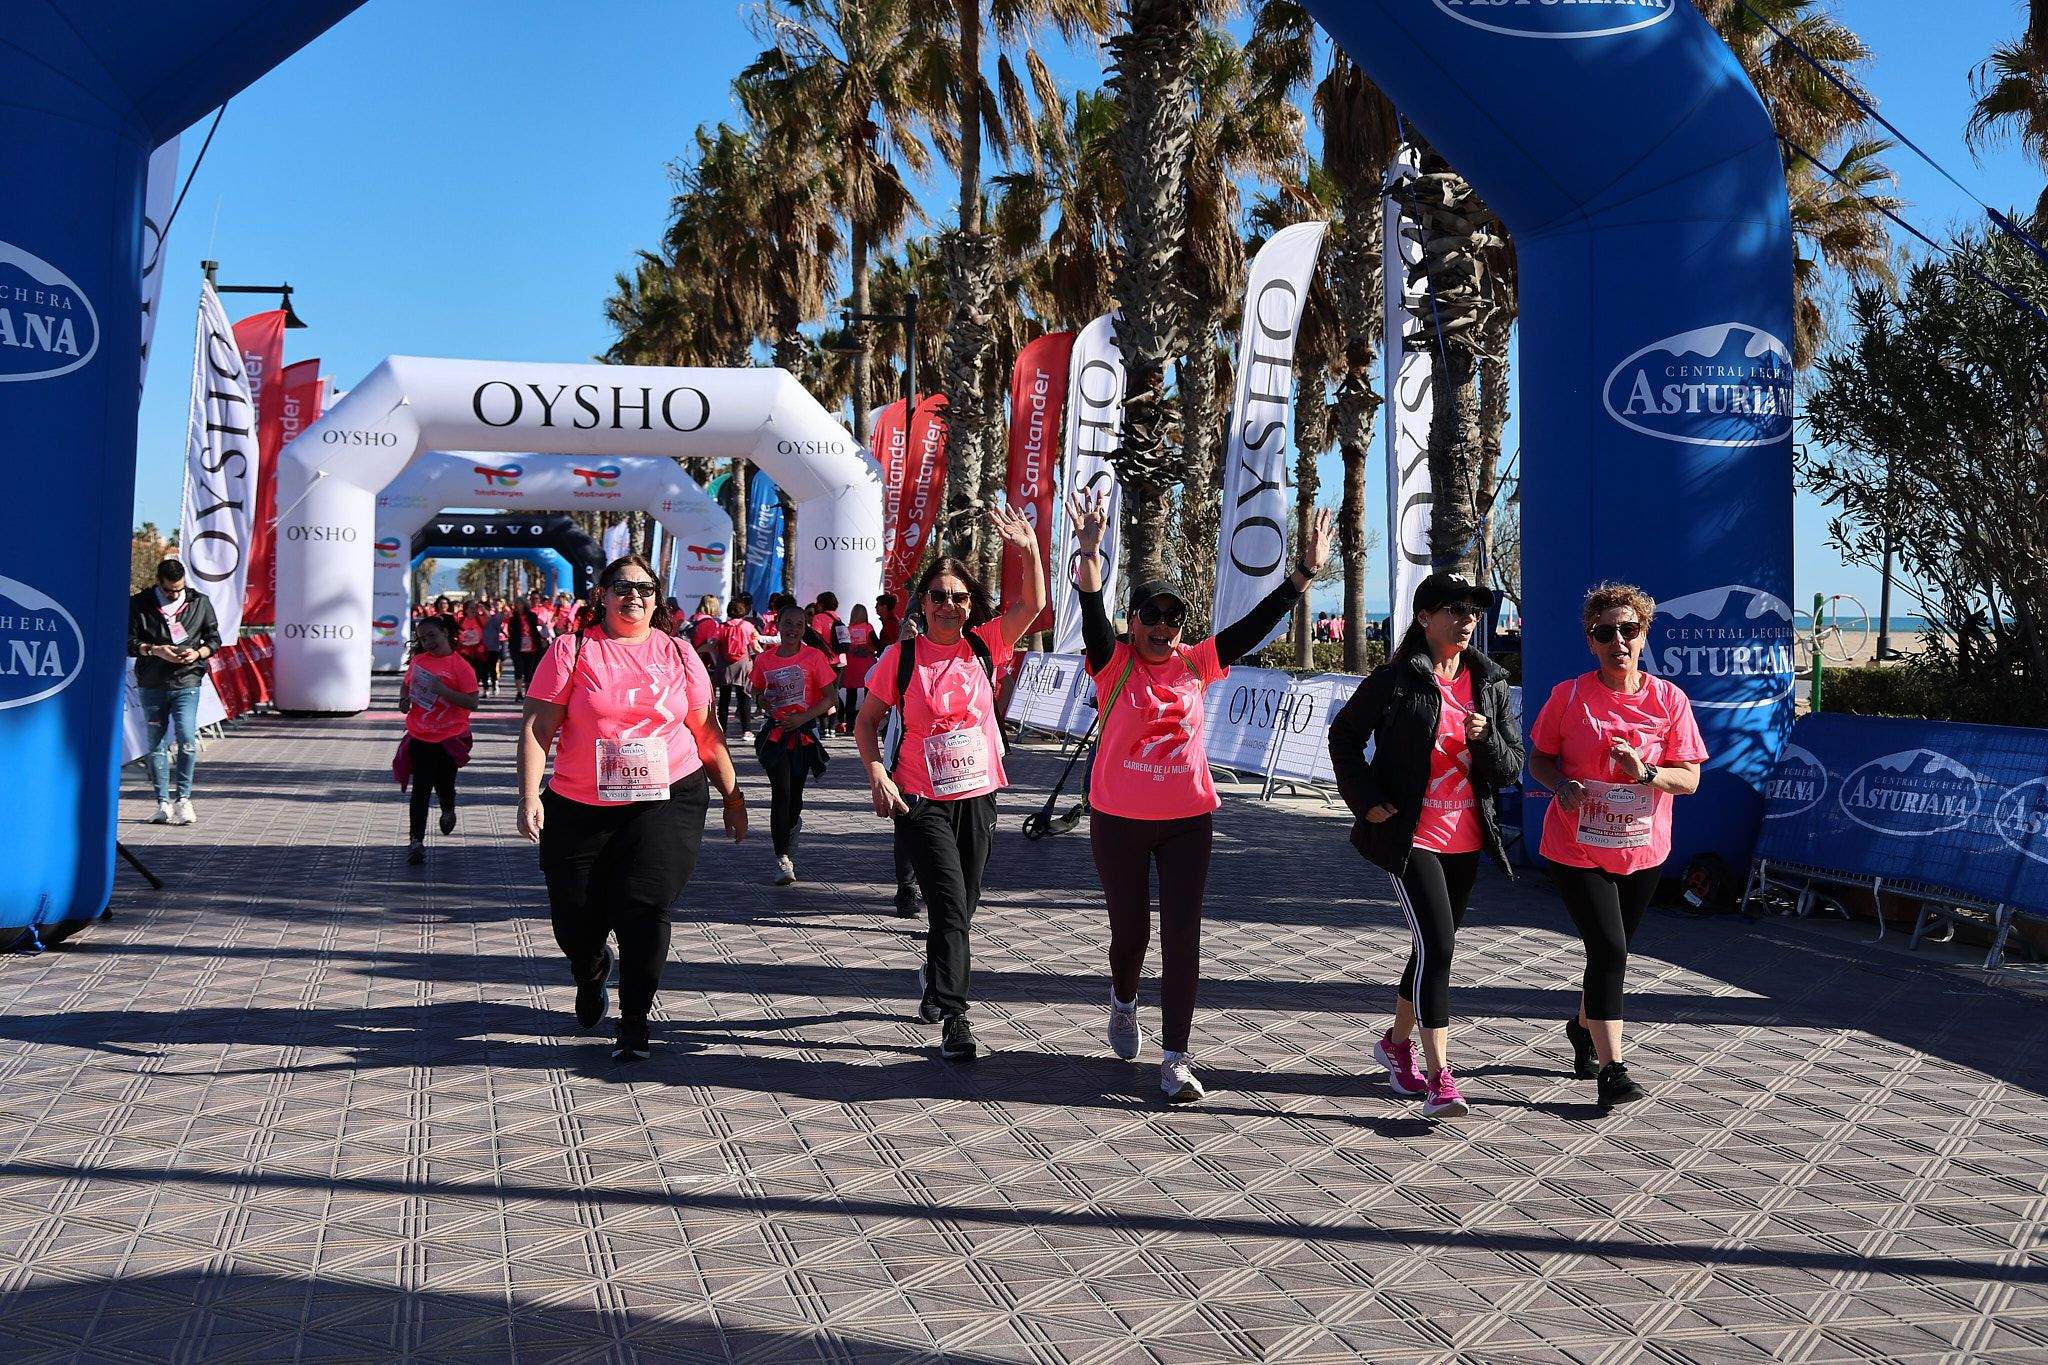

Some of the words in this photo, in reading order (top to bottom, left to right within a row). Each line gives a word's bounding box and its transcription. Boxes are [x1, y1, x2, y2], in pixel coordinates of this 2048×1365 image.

[0, 285, 72, 310] CHERA
[1665, 365, 1745, 378] CENTRAL
[473, 380, 710, 432] OYSHO
[1020, 368, 1050, 498] Santander
[1230, 278, 1297, 578] OYSHO
[322, 429, 397, 447] OYSHO
[777, 440, 844, 455] OYSHO
[884, 427, 906, 526] Santander
[908, 419, 943, 520] Santander
[1067, 359, 1118, 593] OSHO
[474, 489, 524, 498] TotalEnergies
[572, 490, 621, 499] TotalEnergies
[286, 525, 356, 542] OYSHO
[436, 524, 544, 535] VOLVO
[814, 536, 876, 551] OYSHO
[0, 616, 57, 632] HERA
[284, 623, 354, 640] OYSHO
[1666, 628, 1745, 640] CENTRAL
[1228, 685, 1313, 734] OYSHO
[951, 755, 975, 769] 016
[1123, 759, 1152, 773] CARRERA
[1153, 764, 1163, 774] DE
[621, 766, 649, 777] 016
[1874, 776, 1919, 787] CENTRAL
[1765, 779, 1815, 801] RIANA
[1846, 775, 1968, 818] ASTURIANA
[1605, 813, 1634, 824] 016
